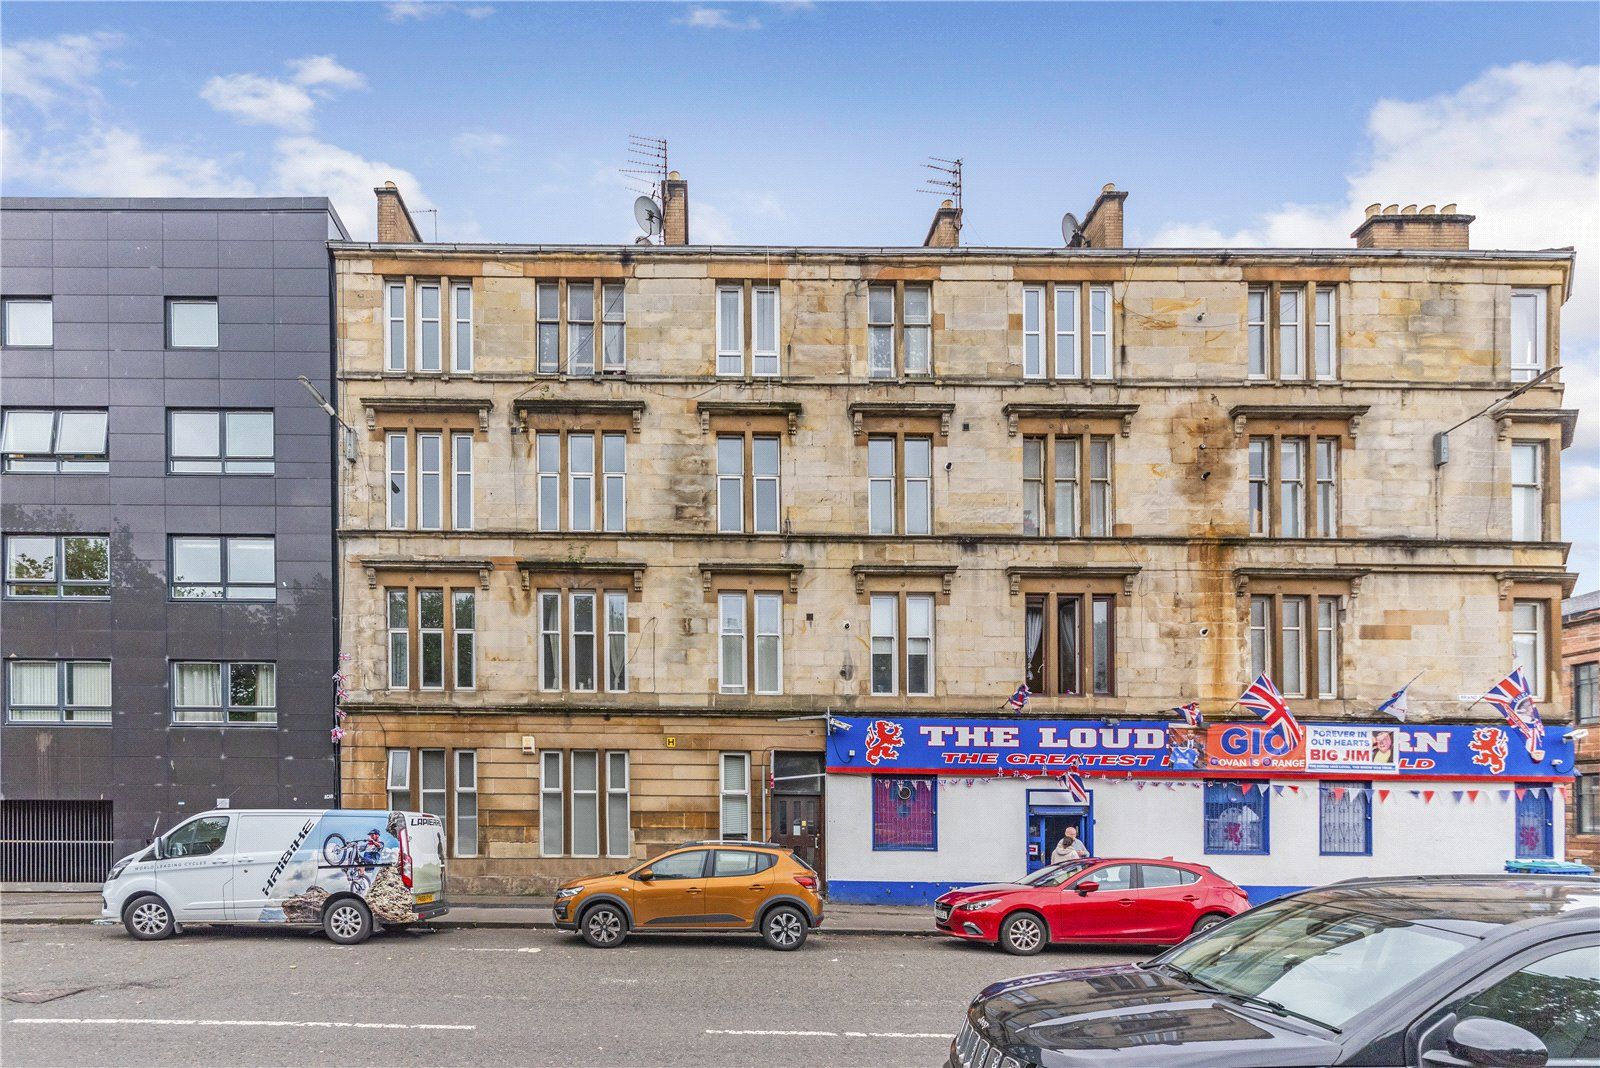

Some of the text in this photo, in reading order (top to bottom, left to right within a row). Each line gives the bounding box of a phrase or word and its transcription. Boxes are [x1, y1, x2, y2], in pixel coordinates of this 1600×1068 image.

[919, 725, 1020, 748] THE
[1038, 727, 1168, 749] LOUD
[1313, 730, 1356, 738] FOREVER
[1220, 726, 1291, 756] GIO
[1334, 739, 1370, 747] HEARTS
[941, 752, 998, 764] THE
[1006, 752, 1157, 766] GREATEST
[1310, 749, 1370, 762] BIG JIM
[1210, 757, 1247, 767] GOVAN
[1262, 757, 1305, 768] ORANGE
[262, 819, 314, 896] HAIBIKE
